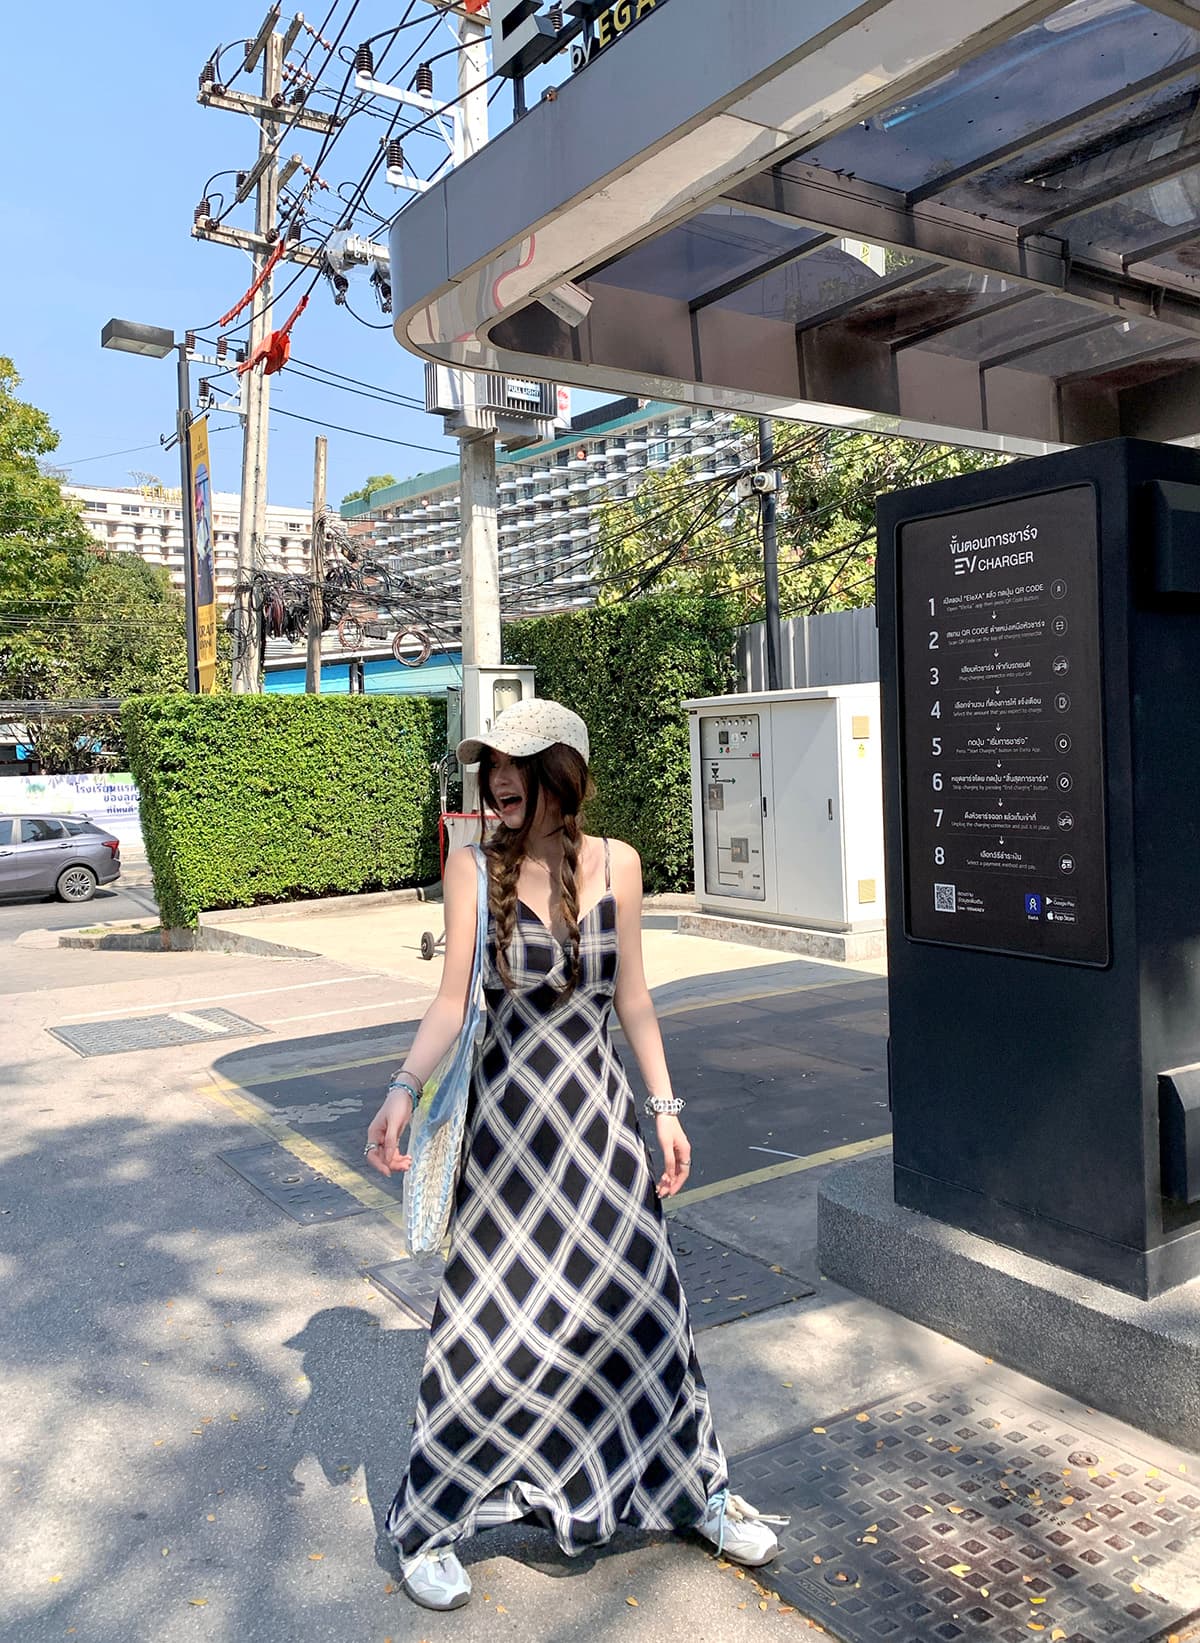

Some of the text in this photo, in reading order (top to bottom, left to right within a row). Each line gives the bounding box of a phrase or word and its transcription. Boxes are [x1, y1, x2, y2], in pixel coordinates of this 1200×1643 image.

[949, 524, 1038, 554] ขั้นตอนการชาร์จ
[978, 551, 1034, 571] CHARGER
[1026, 584, 1044, 592] CODE
[928, 598, 935, 616] 1
[928, 631, 939, 649] 2
[972, 627, 989, 635] CODE
[930, 668, 939, 685] 3
[931, 701, 941, 719] 4
[932, 738, 941, 755] 5
[932, 773, 942, 791] 6
[933, 809, 943, 827] 7
[935, 846, 945, 865] 8
